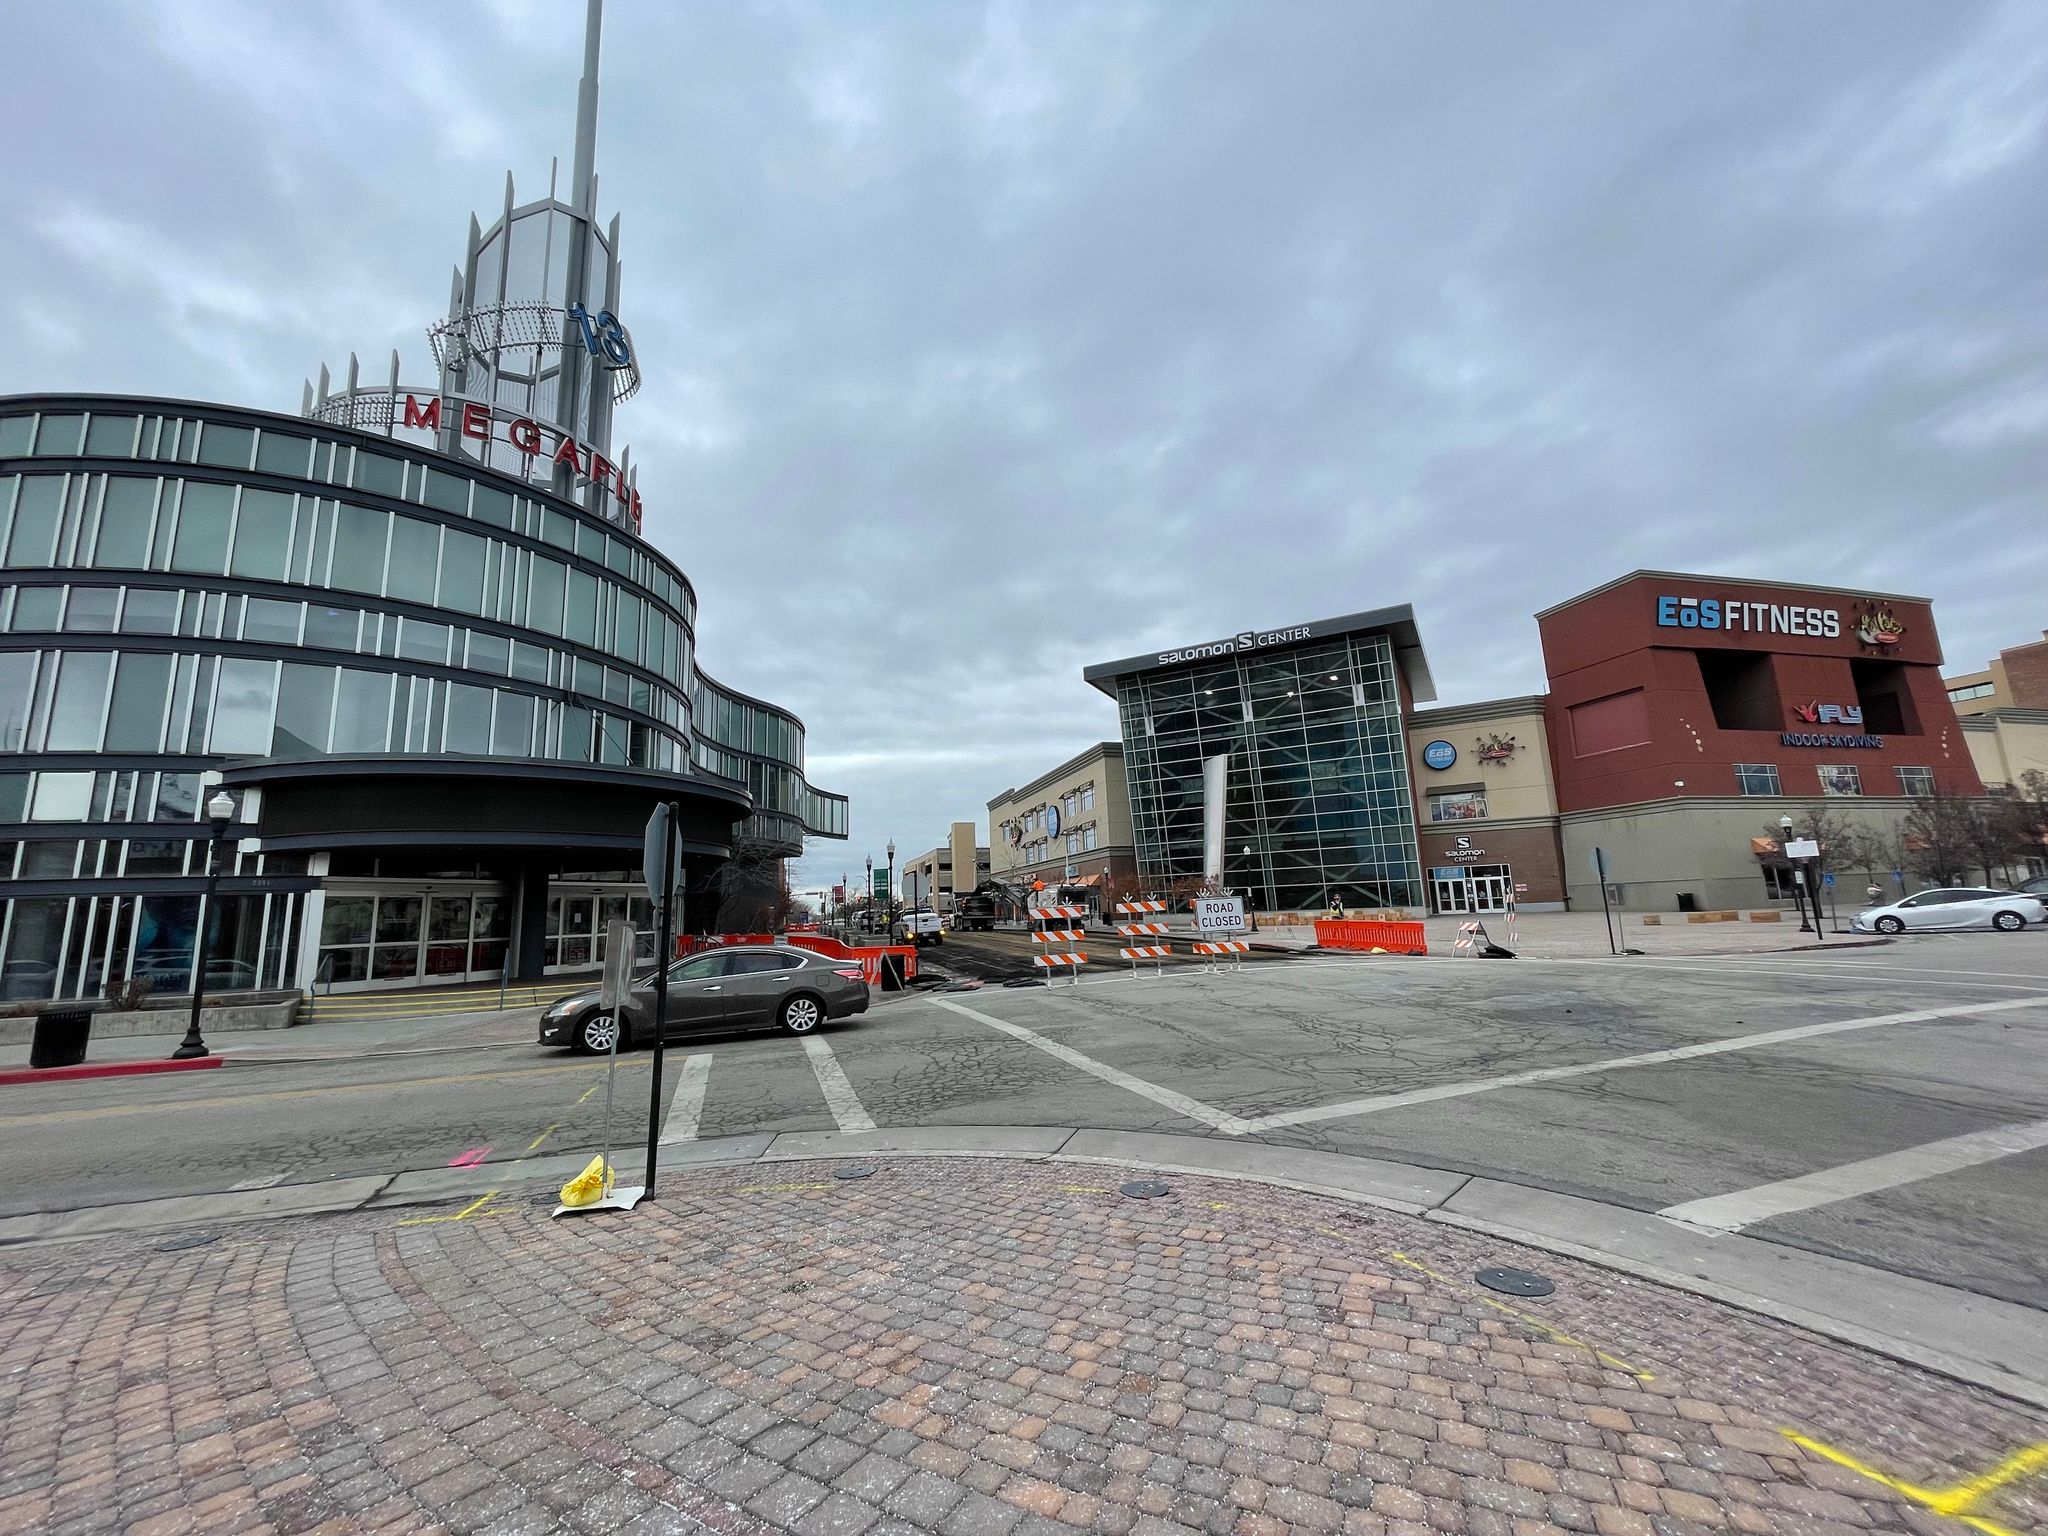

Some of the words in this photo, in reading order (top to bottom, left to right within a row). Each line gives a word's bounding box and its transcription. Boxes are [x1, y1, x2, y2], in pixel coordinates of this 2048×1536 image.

[567, 302, 631, 366] 13
[1725, 601, 1840, 638] FITNESS
[1258, 627, 1312, 646] CENTER
[1782, 733, 1827, 747] INDOOR
[1828, 735, 1884, 748] SKYDIVING
[1206, 903, 1233, 913] ROAD
[1202, 916, 1241, 927] CLOSED
